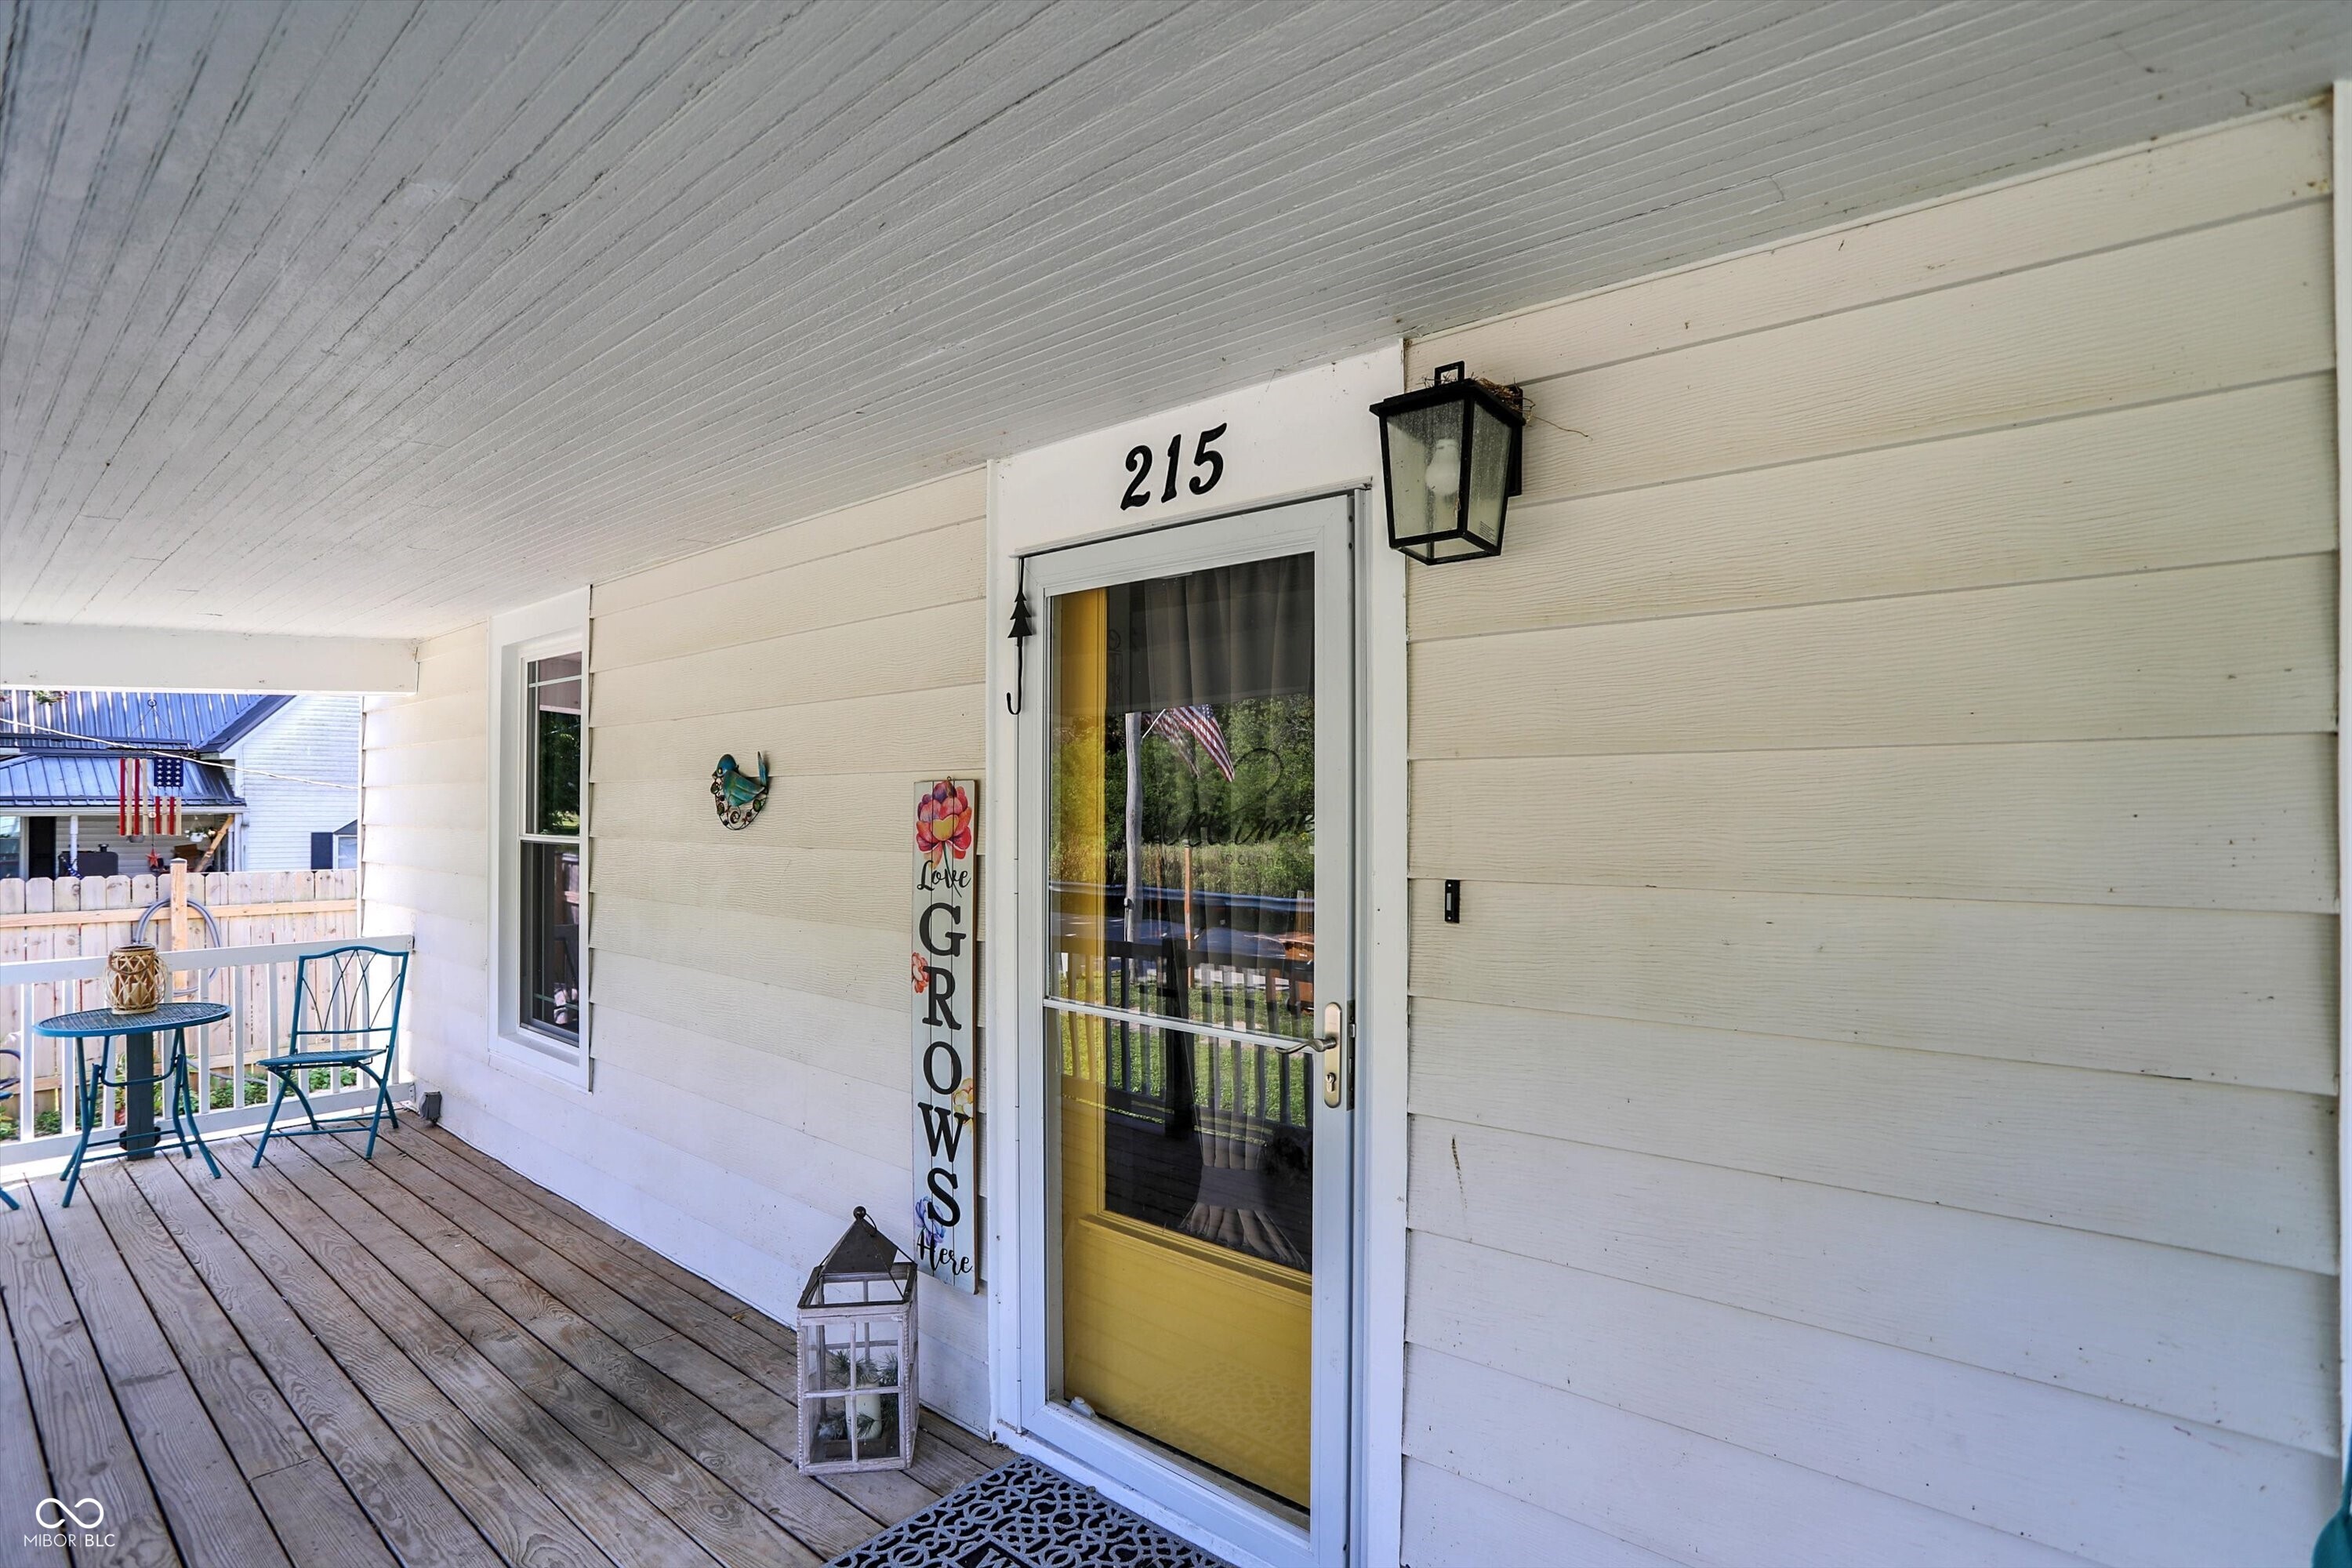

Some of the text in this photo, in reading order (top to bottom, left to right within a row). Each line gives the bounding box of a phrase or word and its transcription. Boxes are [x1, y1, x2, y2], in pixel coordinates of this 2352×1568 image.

[1120, 423, 1228, 511] 215
[916, 859, 971, 891] Love
[917, 902, 972, 1228] GROWS
[916, 1227, 973, 1276] Here
